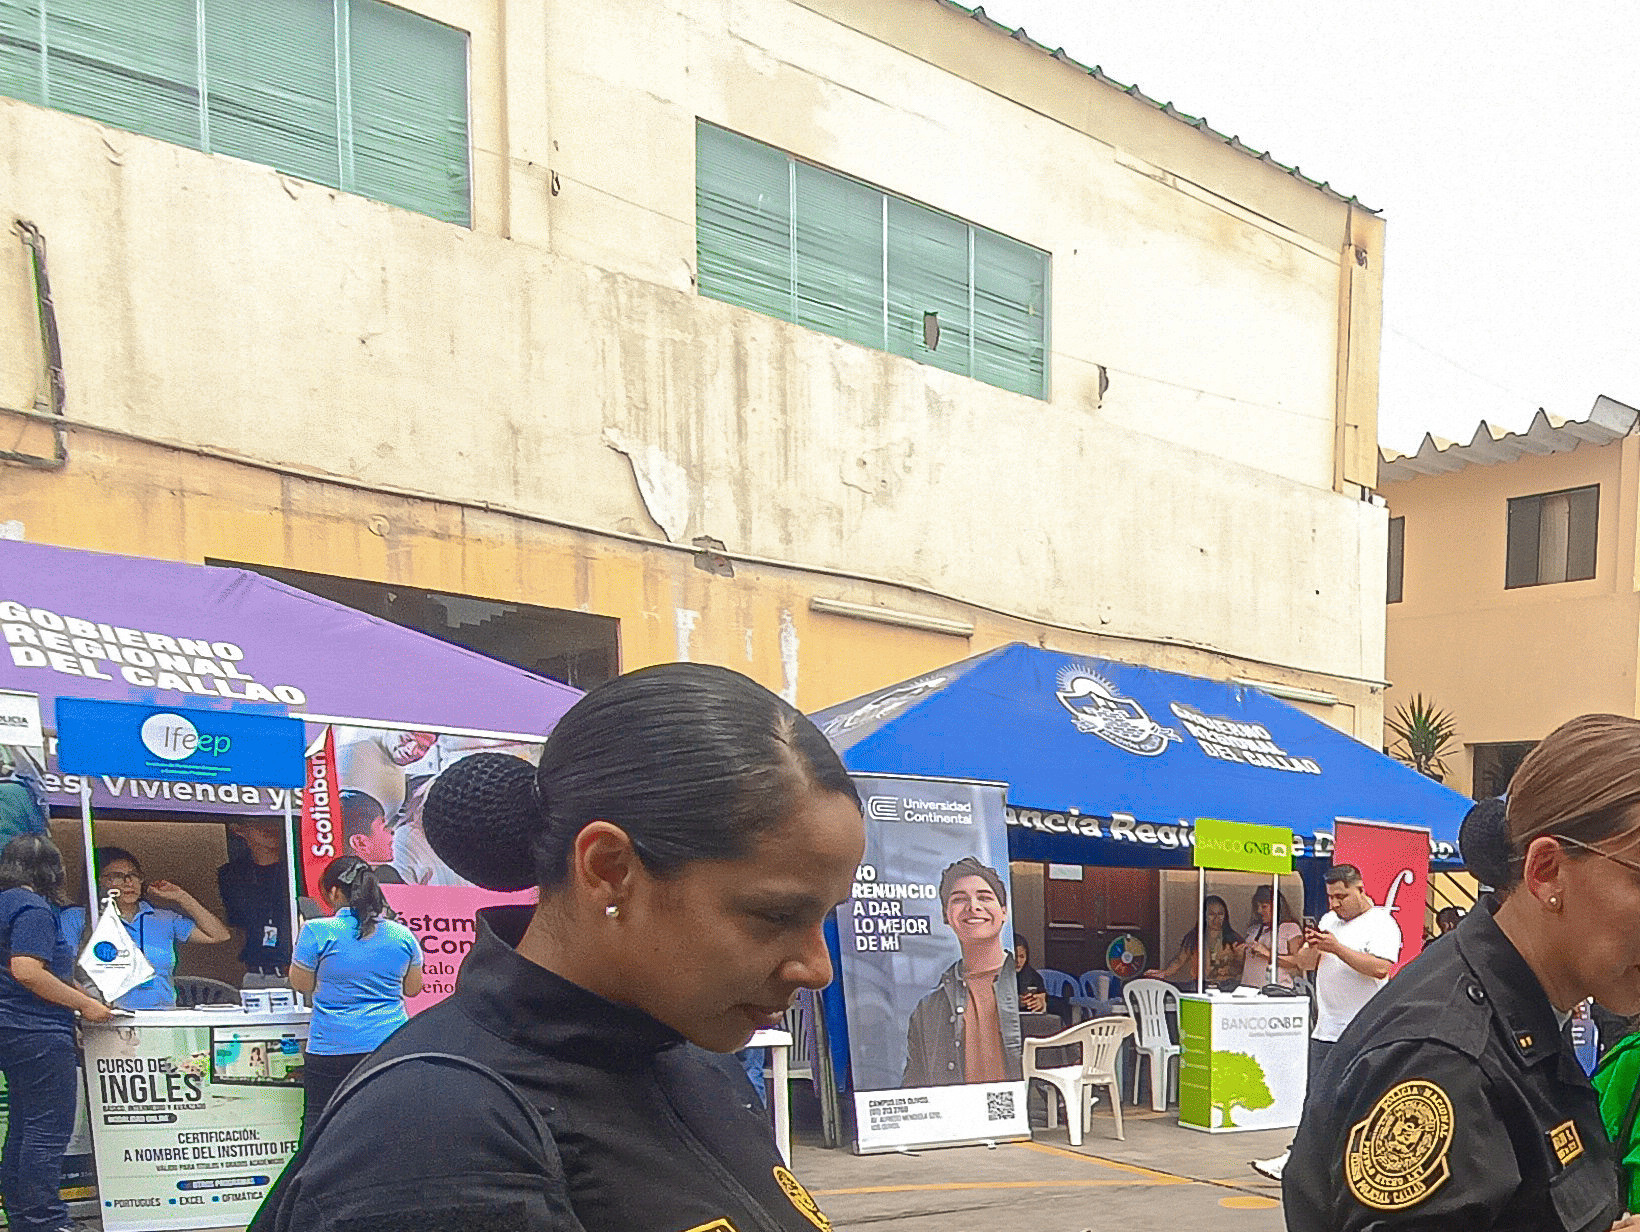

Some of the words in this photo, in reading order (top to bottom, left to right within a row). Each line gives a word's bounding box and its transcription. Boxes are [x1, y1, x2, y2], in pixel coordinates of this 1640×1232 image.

[0, 600, 245, 661] GOBIERNO
[2, 622, 254, 681] REGIONAL
[10, 645, 113, 681] DEL
[121, 665, 307, 705] CALLAO
[1169, 701, 1272, 740] GOBIERNO
[1199, 740, 1247, 764] DEL
[1242, 751, 1322, 776] CALLAO
[102, 774, 260, 805] Vivienda
[309, 752, 335, 858] Scotiaban
[903, 797, 972, 813] Universidad
[904, 811, 973, 825] Continental
[1243, 840, 1271, 856] GNB
[852, 881, 937, 899] RENUNCIO
[853, 901, 866, 916] A
[868, 900, 902, 917] DAR
[854, 918, 875, 934] LO
[877, 918, 930, 934] MEJOR
[420, 935, 476, 955] Con
[856, 935, 878, 951] DE
[1221, 1016, 1268, 1031] BANCO
[1268, 1016, 1291, 1030] GNB
[97, 1058, 143, 1074] CURSO
[147, 1057, 168, 1073] DE
[124, 1149, 132, 1162] A
[135, 1147, 190, 1162] NOMBRE
[193, 1146, 215, 1159] DEL
[218, 1142, 278, 1158] INSTITUTO
[179, 1195, 205, 1206] EXCEL
